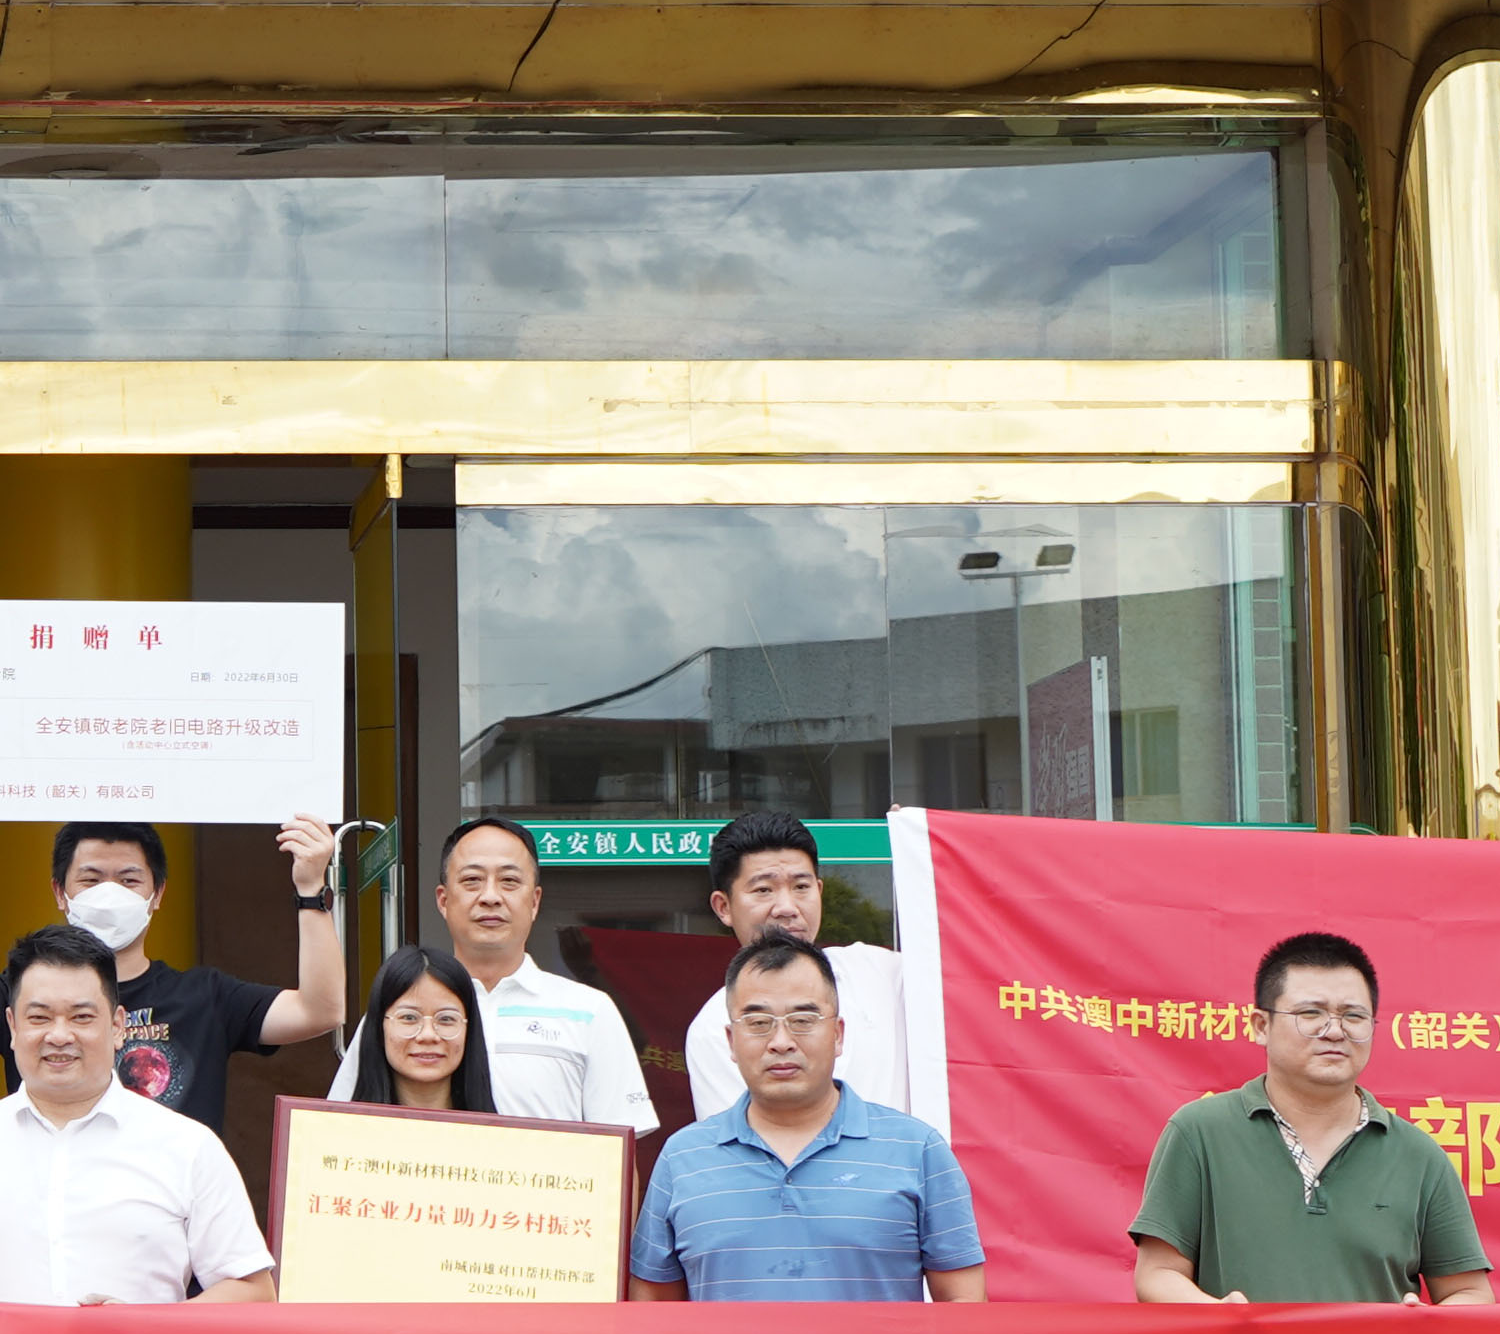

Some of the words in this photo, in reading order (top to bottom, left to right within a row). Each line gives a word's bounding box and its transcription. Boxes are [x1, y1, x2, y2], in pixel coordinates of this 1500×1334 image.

[29, 623, 163, 651] 捐赠单
[223, 672, 300, 684] 2022年6月30日
[34, 716, 301, 738] 全安镇敬老院老旧电路升级改造
[538, 830, 718, 856] 全安镇人民政
[308, 1193, 446, 1225] 汇聚企业力量
[453, 1207, 593, 1238] 助力乡村振兴
[467, 1282, 537, 1300] 2022年6月
